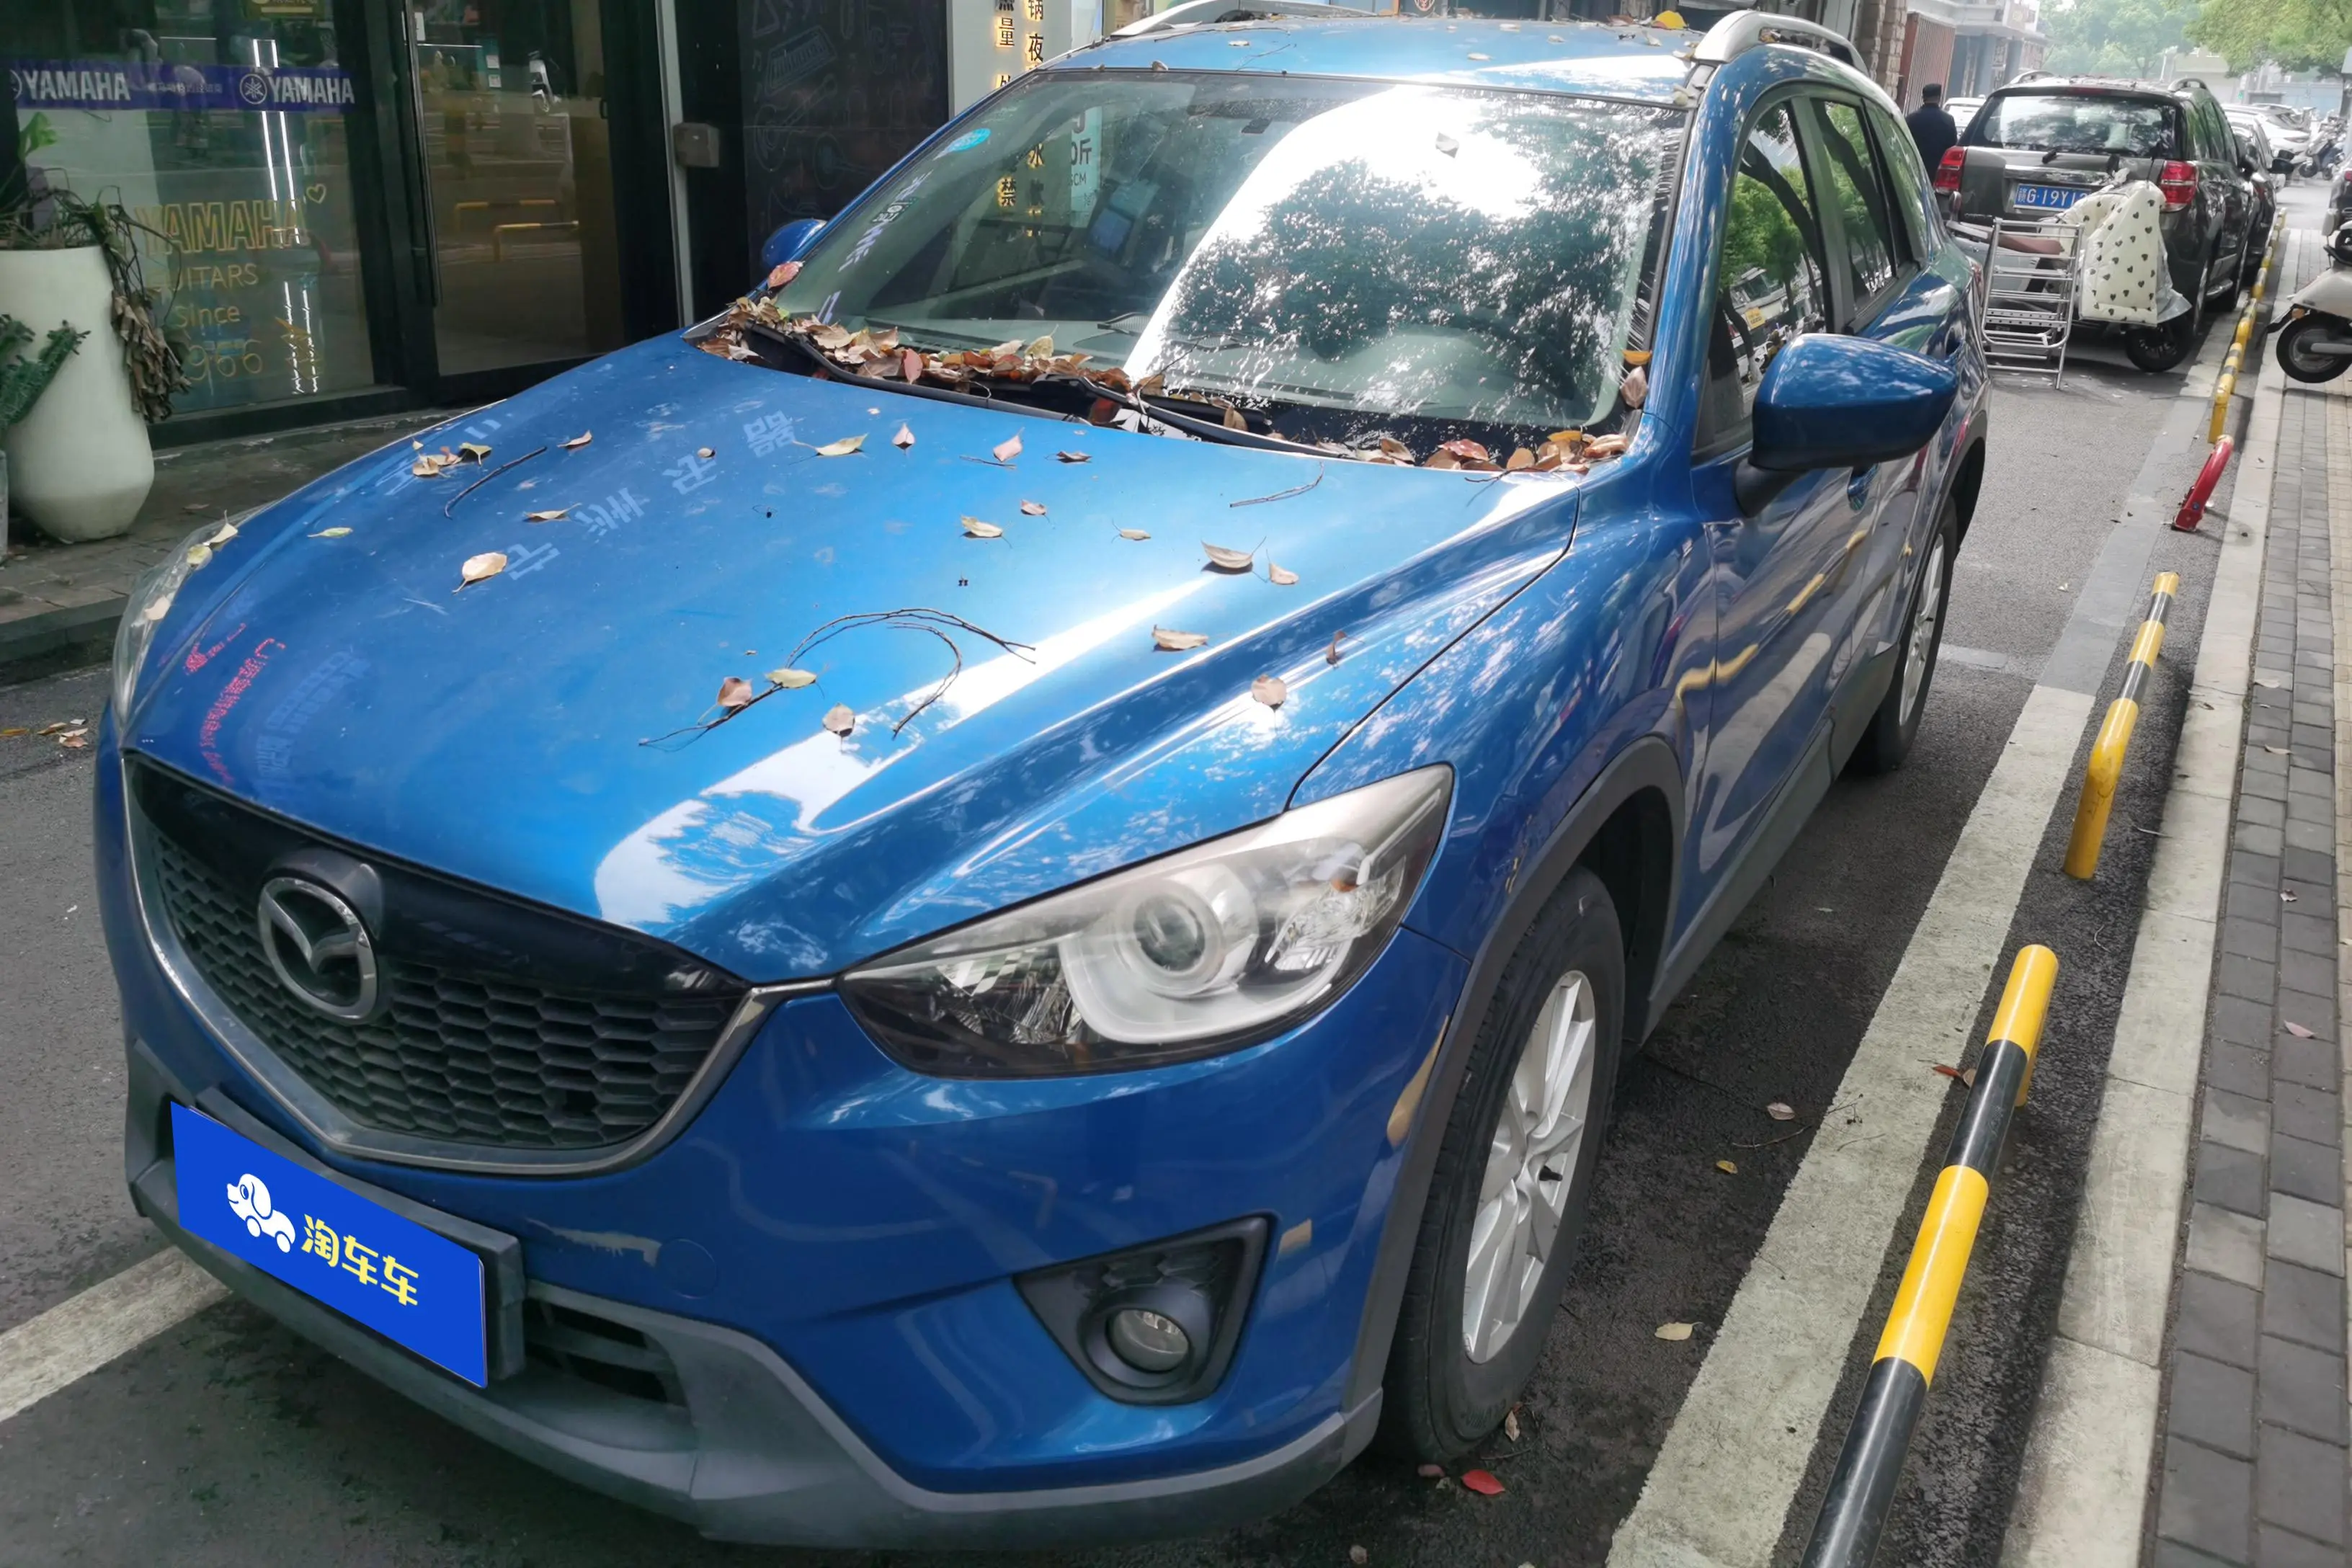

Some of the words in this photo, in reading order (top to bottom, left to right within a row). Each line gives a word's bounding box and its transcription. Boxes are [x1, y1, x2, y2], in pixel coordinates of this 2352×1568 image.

[22, 70, 131, 101] YAMAHA
[267, 76, 356, 104] YAMAHA
[133, 200, 311, 255] YAMAHA
[187, 338, 262, 381] 966
